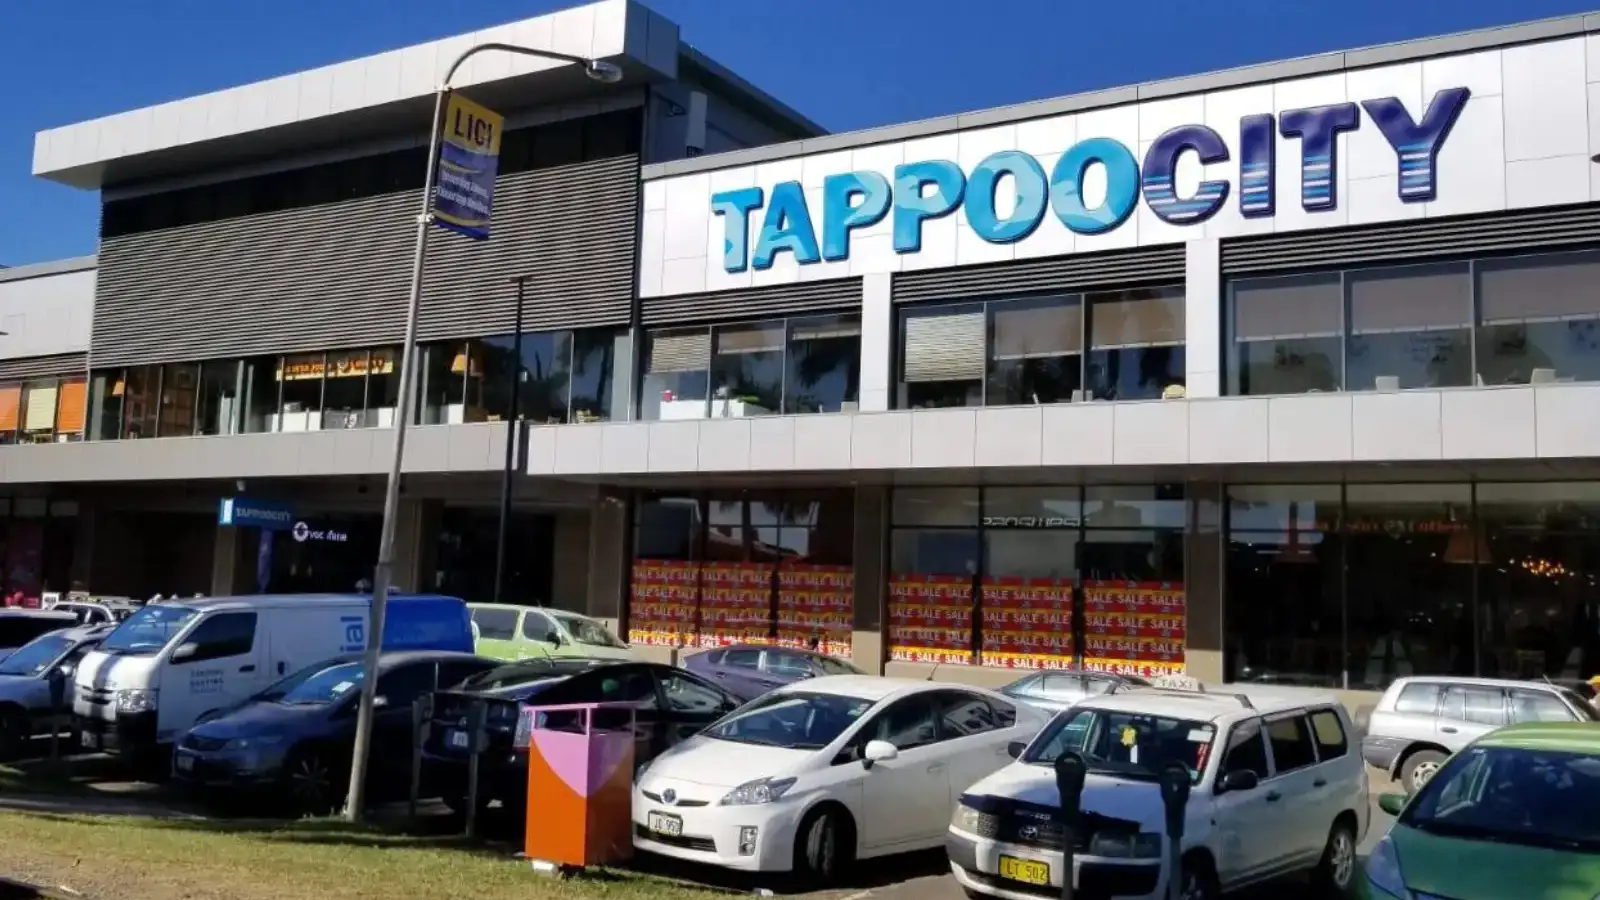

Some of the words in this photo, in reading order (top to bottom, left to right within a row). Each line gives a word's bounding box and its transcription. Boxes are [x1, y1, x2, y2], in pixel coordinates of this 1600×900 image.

[454, 108, 493, 148] LICI
[711, 86, 1471, 273] TAPPOOCITY
[891, 649, 912, 661] SALE
[917, 651, 941, 662] SALE
[945, 652, 969, 664] SALE
[982, 656, 1008, 668] SALE
[1013, 658, 1039, 669] SALE
[1042, 659, 1069, 670] SALE
[1161, 679, 1192, 689] TAXI
[1025, 864, 1046, 881] 502
